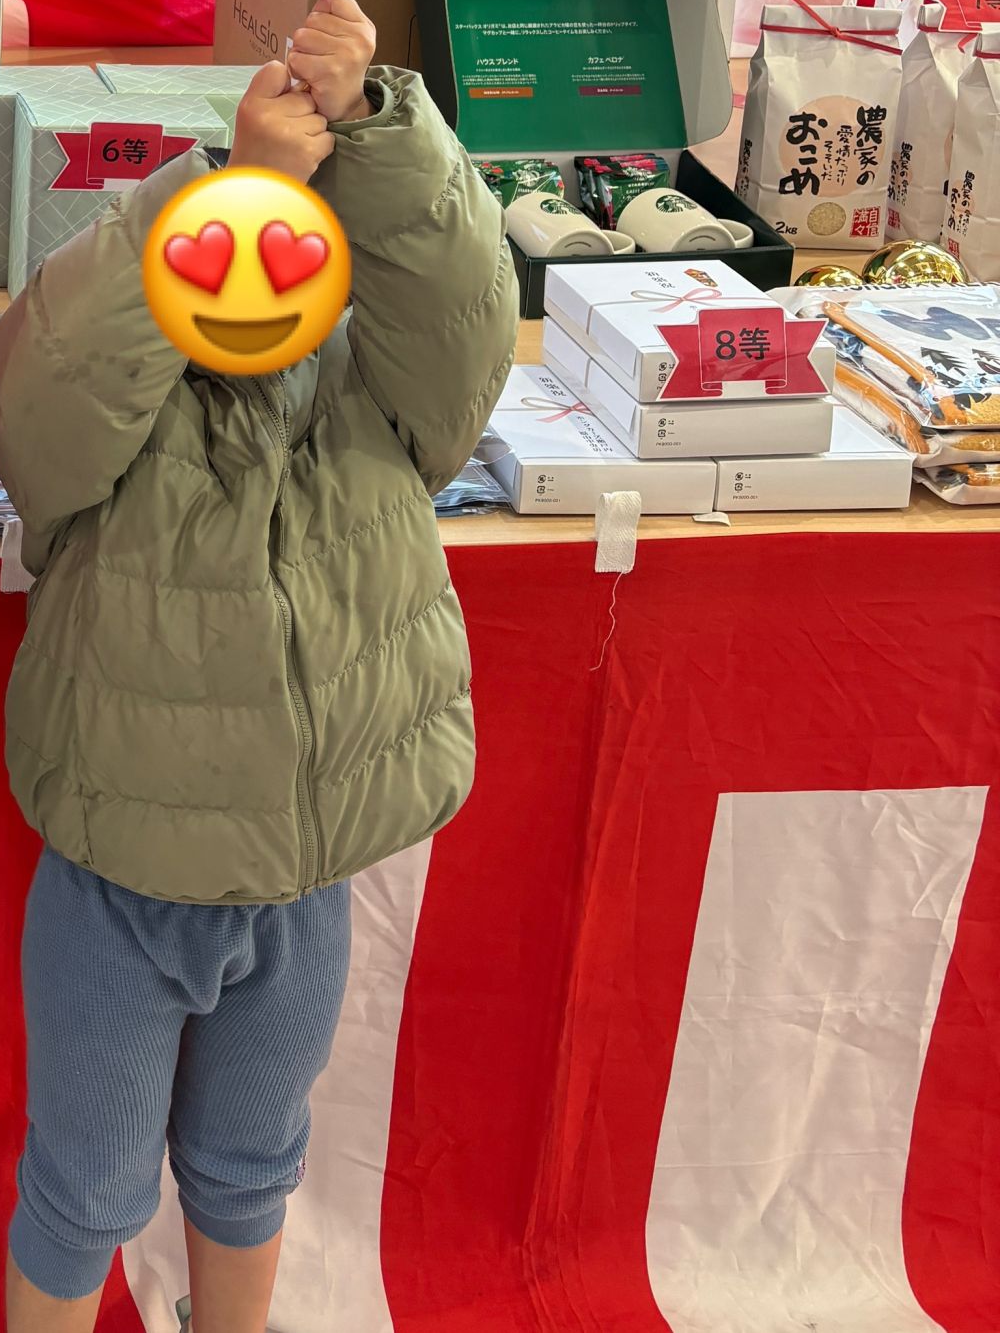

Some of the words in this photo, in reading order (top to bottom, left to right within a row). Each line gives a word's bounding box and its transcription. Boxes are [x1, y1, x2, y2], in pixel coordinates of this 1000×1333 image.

[102, 138, 150, 164] 6等
[778, 112, 828, 196] おこめ
[835, 124, 854, 187] 愛情たっぷり
[854, 105, 887, 186] 農家の
[775, 221, 798, 235] 2kg
[714, 328, 772, 361] 8等
